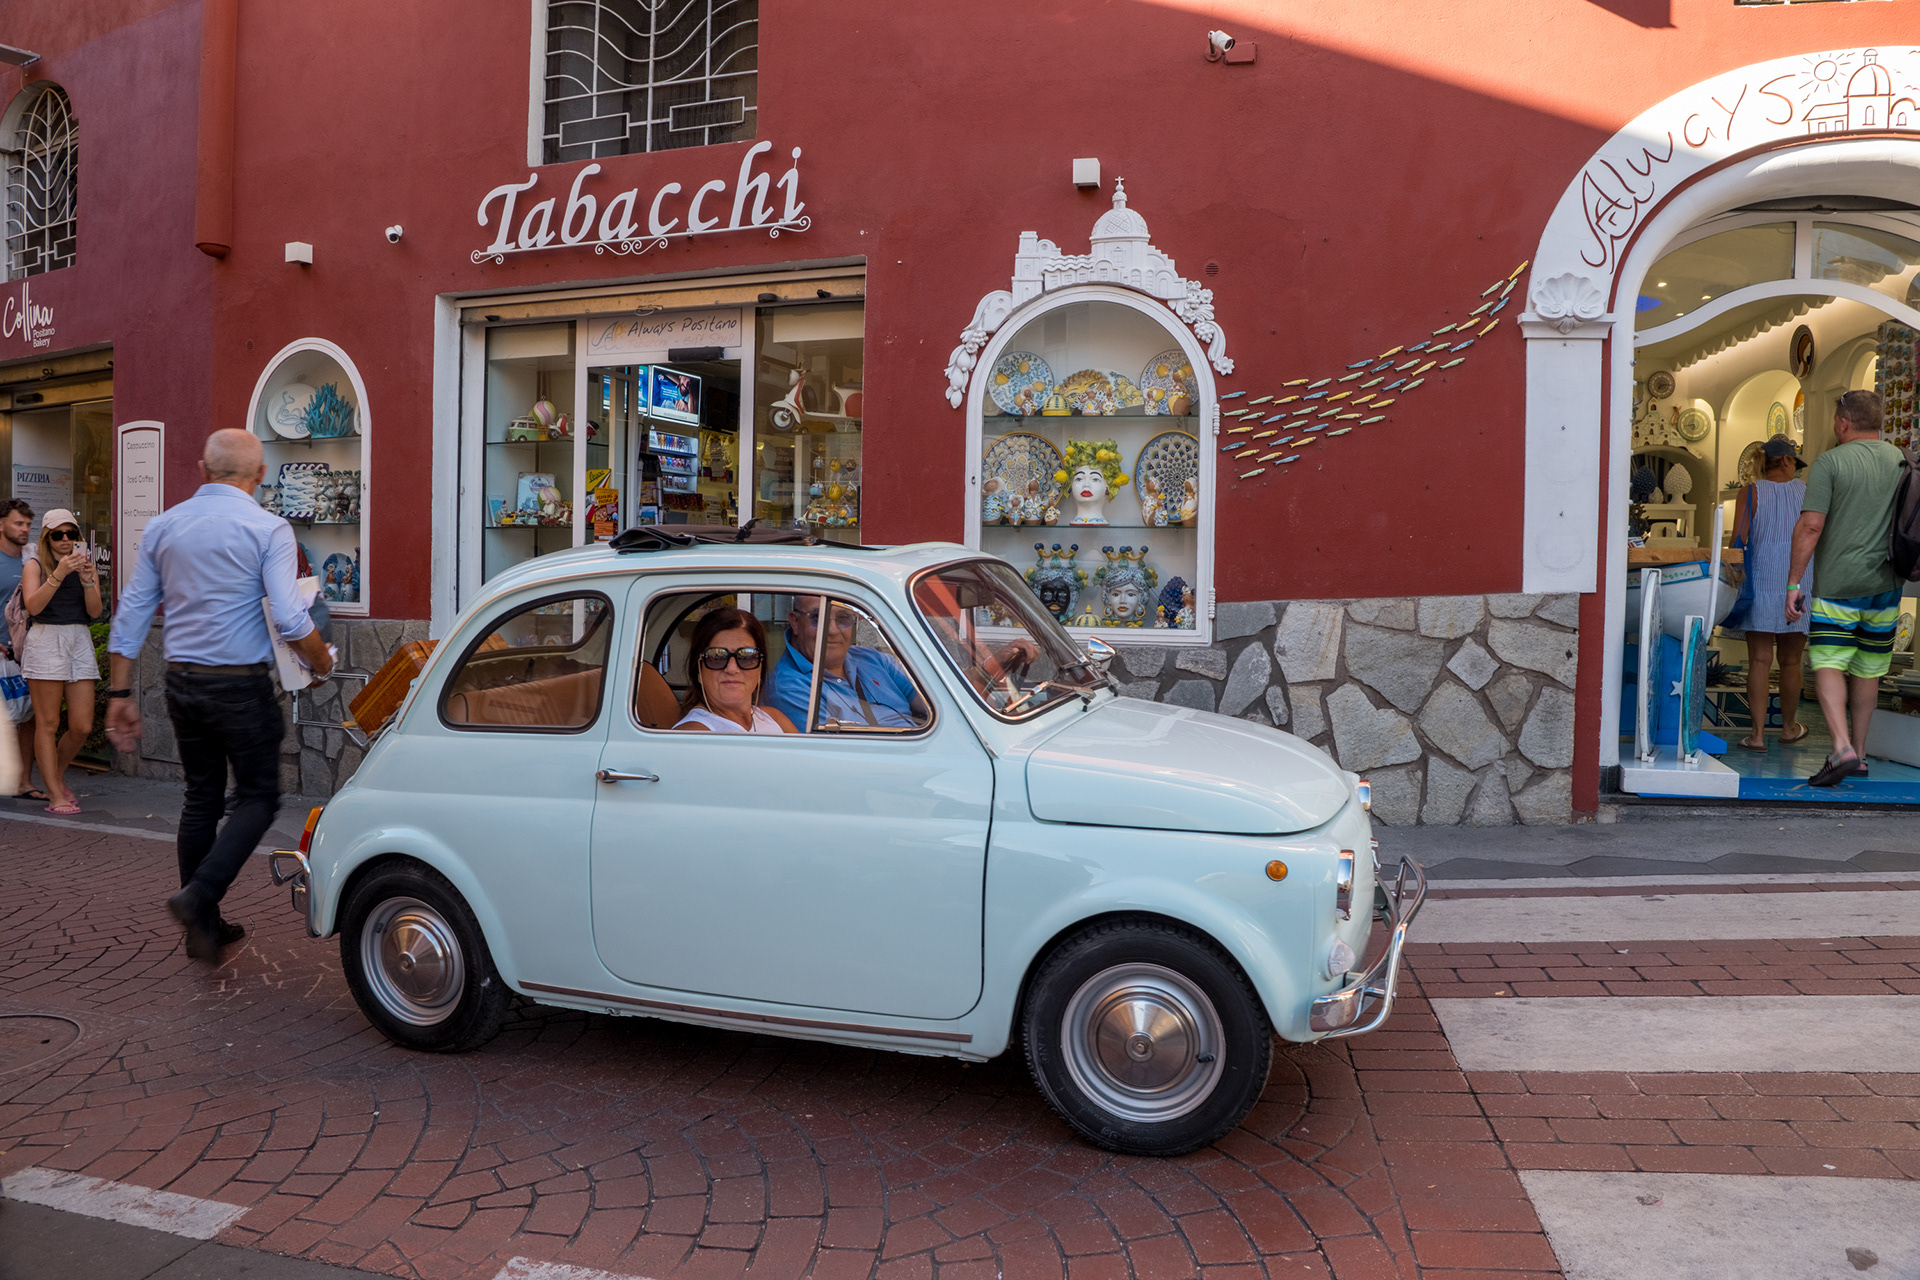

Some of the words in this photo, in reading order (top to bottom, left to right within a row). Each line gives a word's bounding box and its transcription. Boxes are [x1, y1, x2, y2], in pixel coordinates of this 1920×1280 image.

[477, 140, 805, 252] Tabacchi
[3, 281, 54, 342] Collina
[627, 321, 676, 337] Always
[681, 315, 737, 332] Positano
[33, 328, 56, 338] Positano
[33, 338, 51, 348] Bakery
[127, 442, 155, 451] Cappuccino
[17, 471, 50, 484] PIZZERIA
[139, 475, 154, 483] Coffee
[133, 509, 158, 517] Chocolate
[86, 529, 111, 568] ollina
